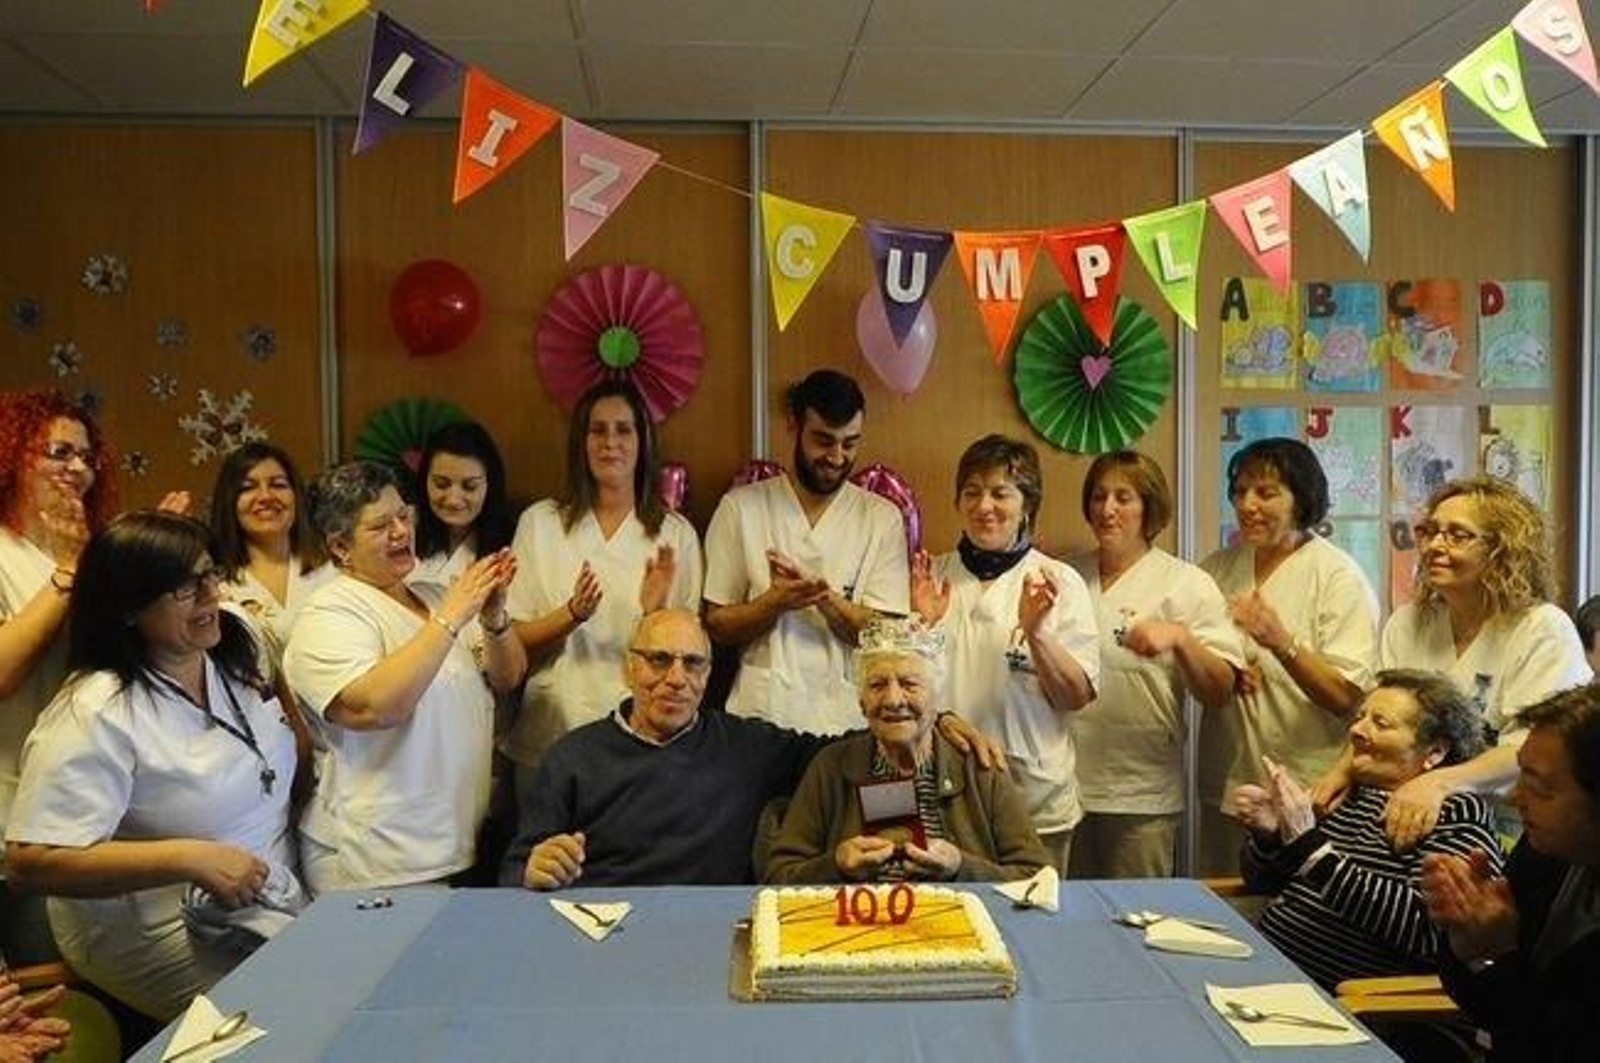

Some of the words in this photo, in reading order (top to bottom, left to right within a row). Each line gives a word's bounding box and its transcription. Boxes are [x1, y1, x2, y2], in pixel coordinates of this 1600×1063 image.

[776, 1, 1583, 304] CUMPLEAÑOS
[1220, 277, 1249, 321] A
[1308, 282, 1338, 318] B
[1387, 280, 1416, 318] C
[1480, 281, 1504, 317] D
[1221, 408, 1242, 441] I
[1306, 407, 1334, 438] J
[1390, 406, 1412, 438] K
[1478, 405, 1501, 435] L
[834, 882, 916, 927] 100
